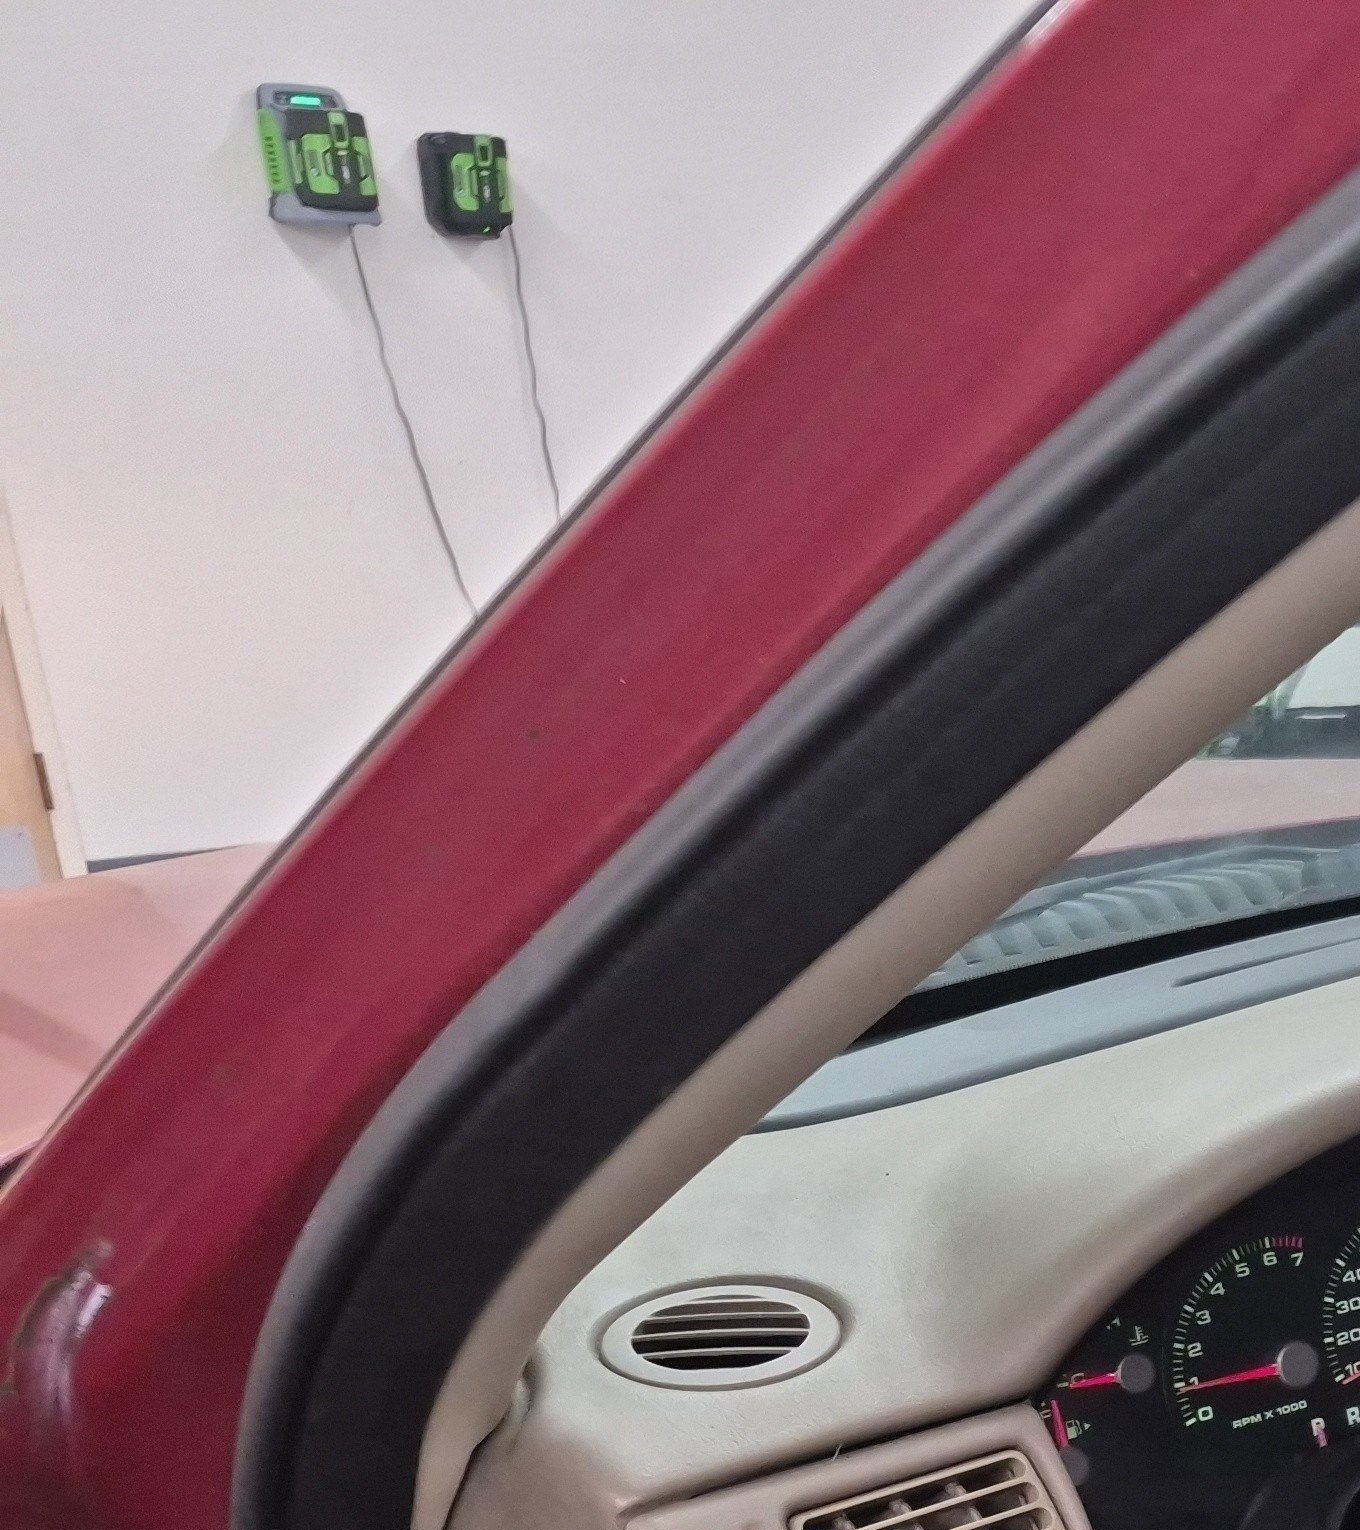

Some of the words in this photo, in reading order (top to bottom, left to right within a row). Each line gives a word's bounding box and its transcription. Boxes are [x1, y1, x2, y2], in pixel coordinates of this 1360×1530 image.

[1263, 1252, 1277, 1265] 6
[1291, 1252, 1304, 1266] 7
[1235, 1263, 1250, 1278] 5
[1209, 1282, 1225, 1296] 4
[1195, 1310, 1212, 1325] 3
[1187, 1342, 1203, 1358] 2
[1197, 1406, 1213, 1421] 0
[1232, 1413, 1262, 1429] RPM
[1264, 1410, 1274, 1420] X
[1276, 1400, 1308, 1416] 1000
